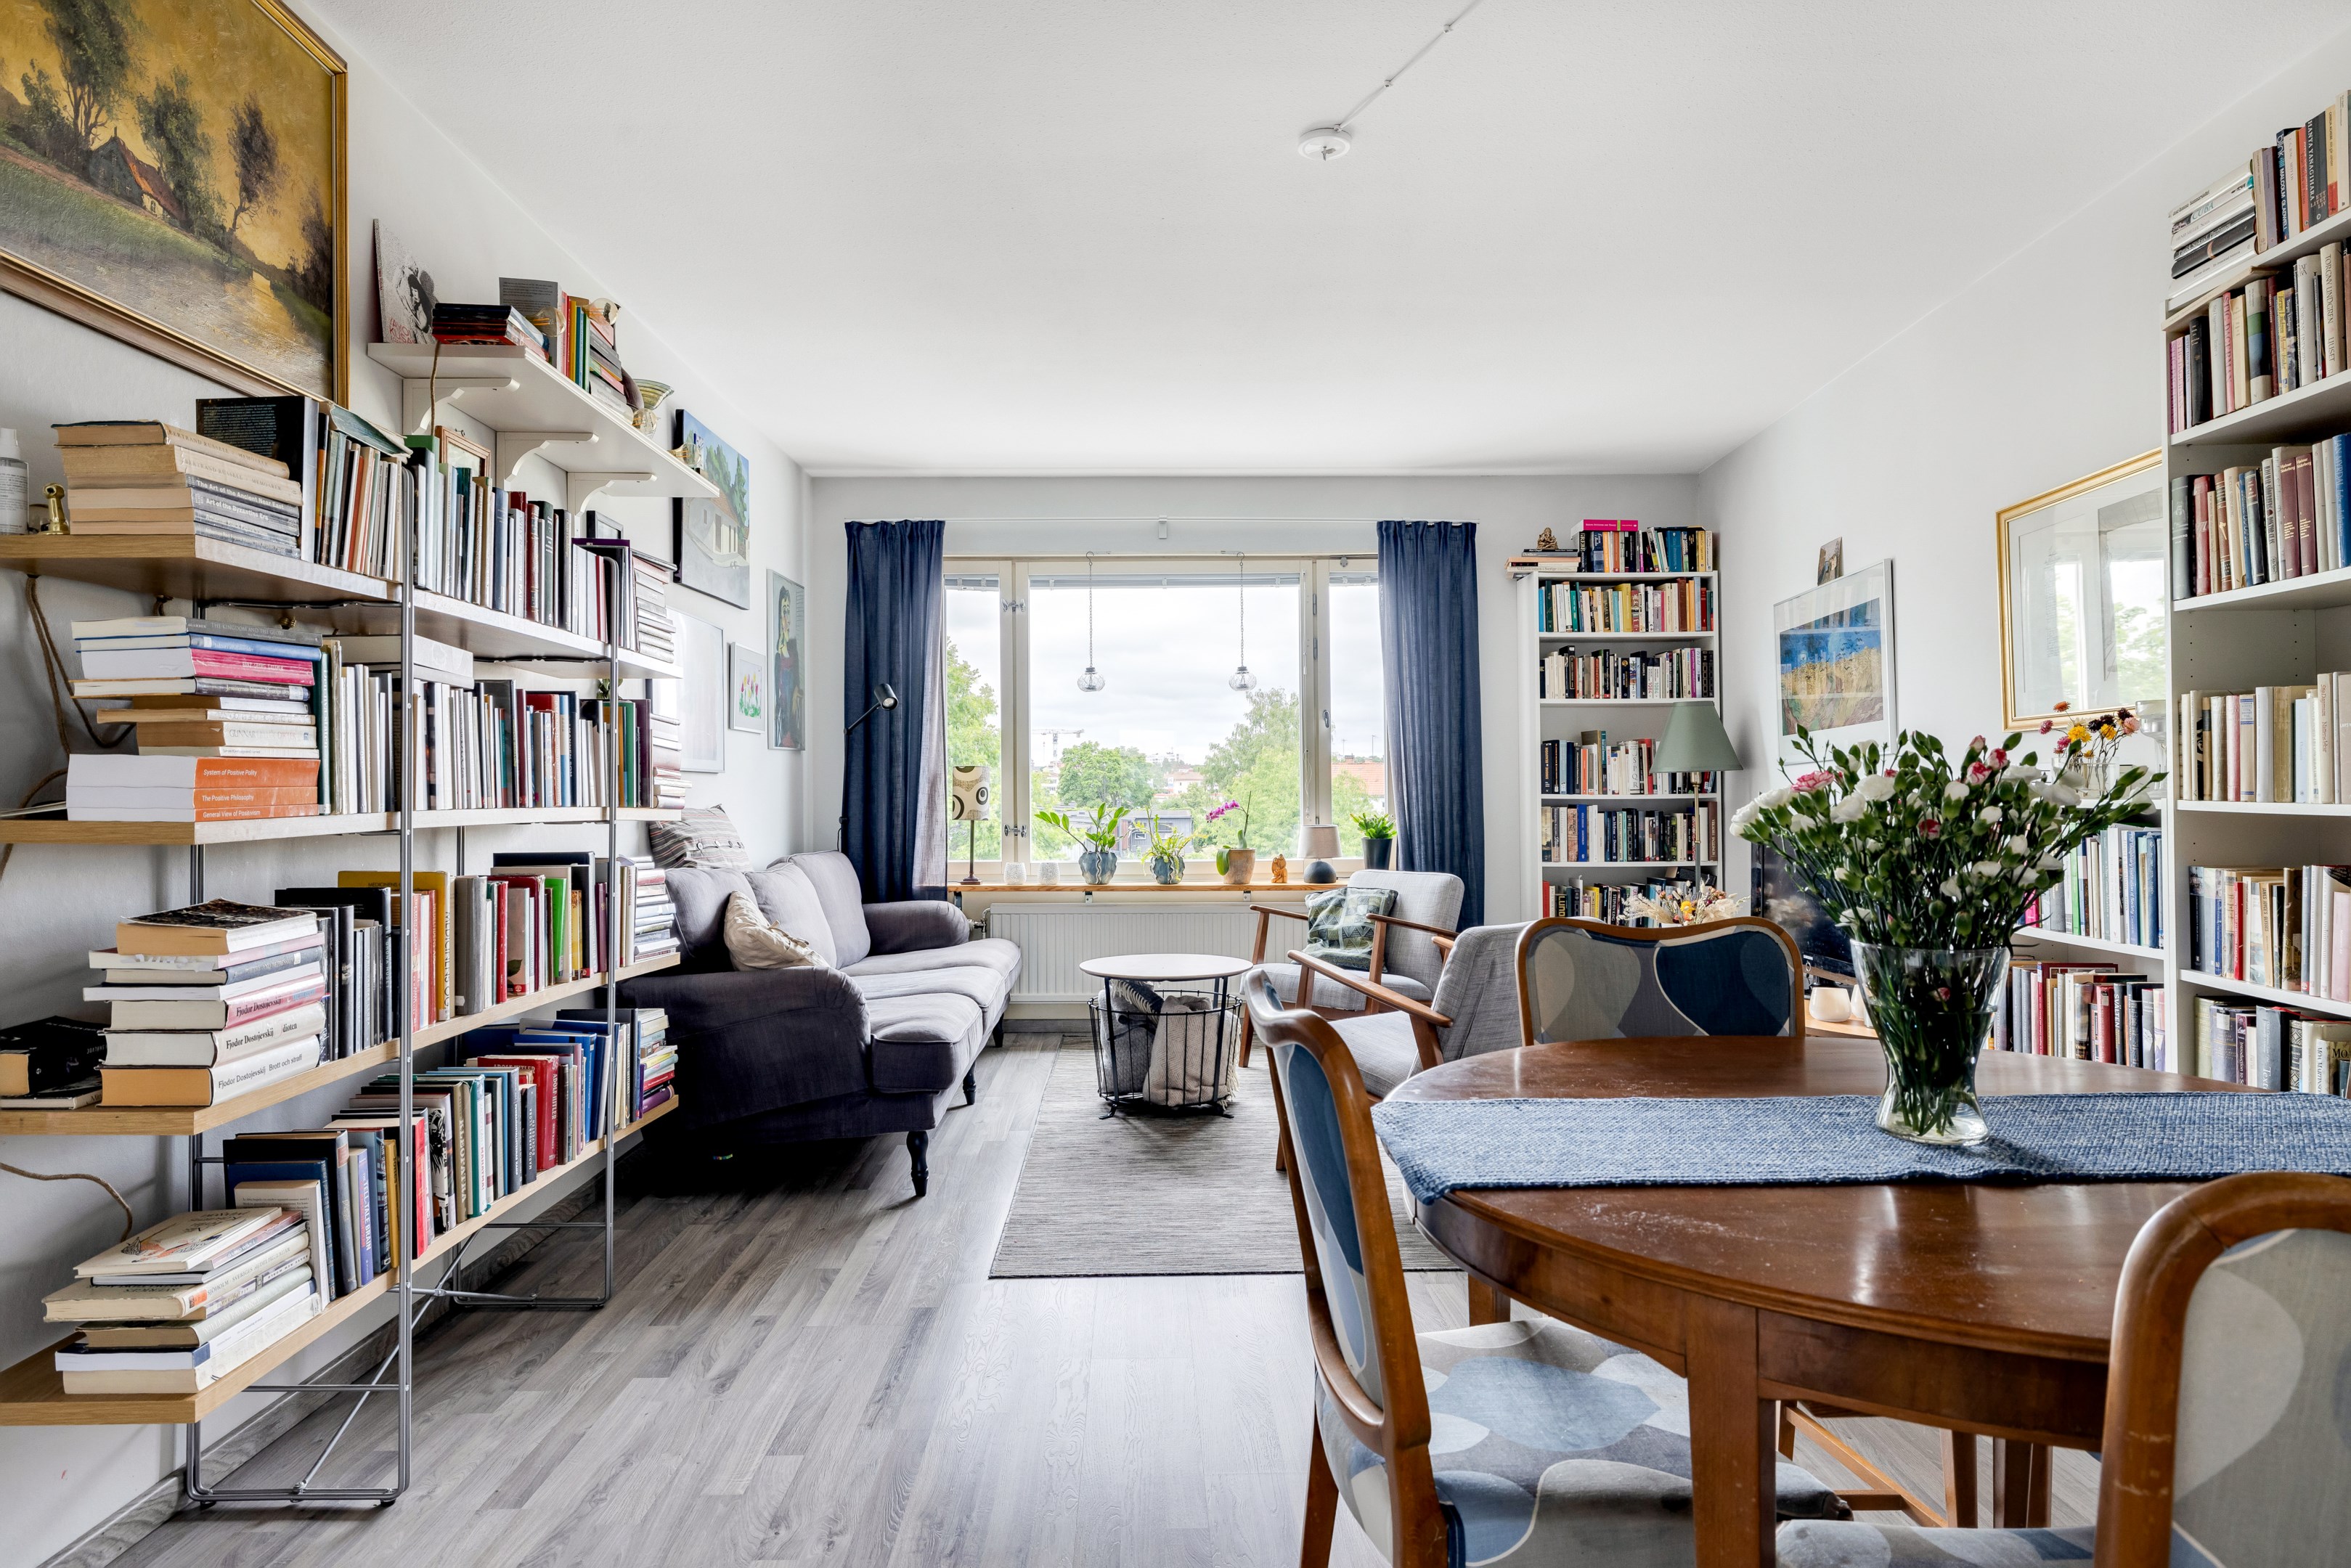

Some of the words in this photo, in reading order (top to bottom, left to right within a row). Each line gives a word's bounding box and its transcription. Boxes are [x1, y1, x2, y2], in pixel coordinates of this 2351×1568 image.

[2192, 202, 2214, 220] CUBA
[2326, 286, 2334, 324] LINDGREN
[196, 480, 208, 489] The
[208, 483, 219, 491] Art
[227, 488, 236, 497] the
[237, 491, 258, 503] Ancient
[258, 497, 272, 507] Near
[272, 500, 285, 510] East
[206, 498, 216, 507] Art
[222, 502, 232, 511] the
[232, 505, 259, 518] Byzantine
[259, 511, 269, 520] Era
[229, 728, 256, 738] GUNNAR
[236, 1004, 253, 1018] Fjodor
[253, 996, 282, 1012] Dostojevskij
[226, 1038, 243, 1050] Fjodor
[244, 1027, 274, 1045] Dostojevskij
[219, 1078, 235, 1089] Fjodor
[236, 1066, 266, 1083] Dostojevskij
[269, 1062, 281, 1072] Brott
[290, 1053, 303, 1065] straff
[207, 1281, 229, 1295] SJÖHOLM
[232, 1269, 253, 1282] SVERIGES
[203, 1311, 231, 1335] WILLIAM
[231, 1295, 263, 1320] FAULKNER
